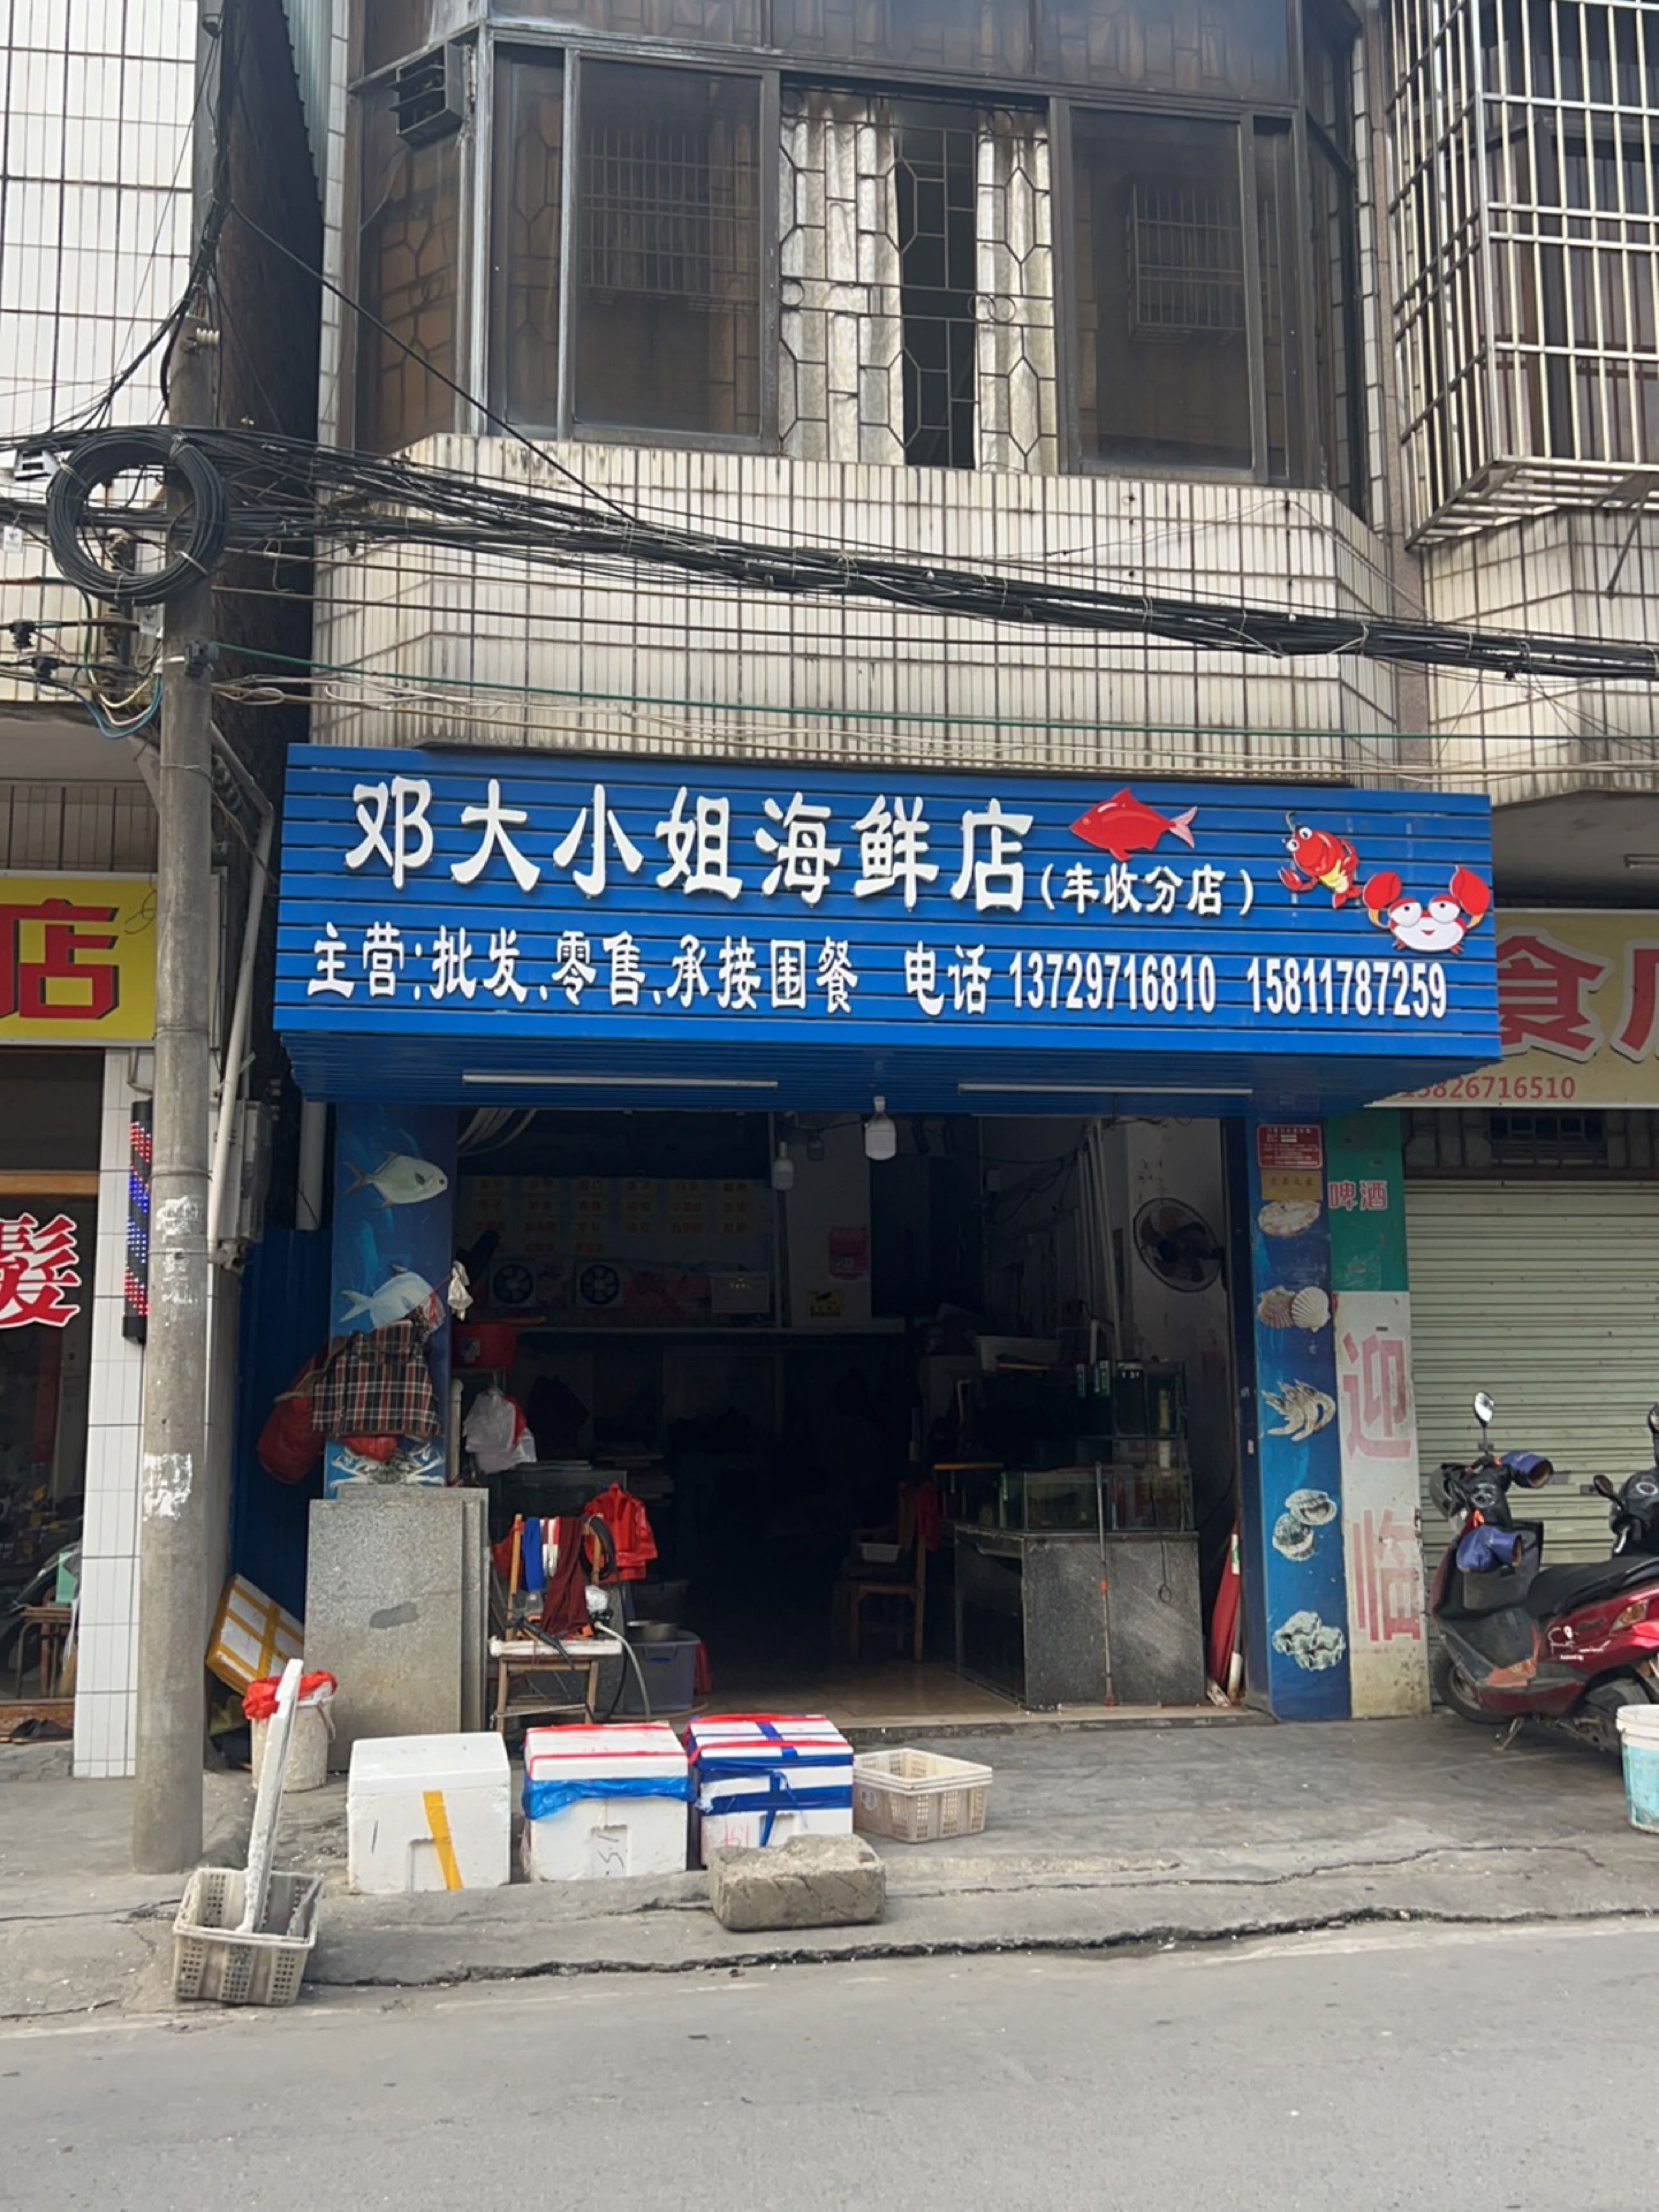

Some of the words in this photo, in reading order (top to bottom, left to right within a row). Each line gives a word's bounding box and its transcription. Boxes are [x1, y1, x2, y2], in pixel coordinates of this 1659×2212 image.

[346, 776, 1033, 911] 邓大小姐海鲜店
[1041, 862, 1253, 915] （丰收分店）
[0, 898, 119, 1020] 店
[905, 941, 991, 1015] 电话
[1010, 951, 1215, 1013] 13729716810
[1247, 957, 1447, 1018] 15811787259
[1401, 1077, 1576, 1099] 826716510
[1328, 1180, 1388, 1211] 啤酒
